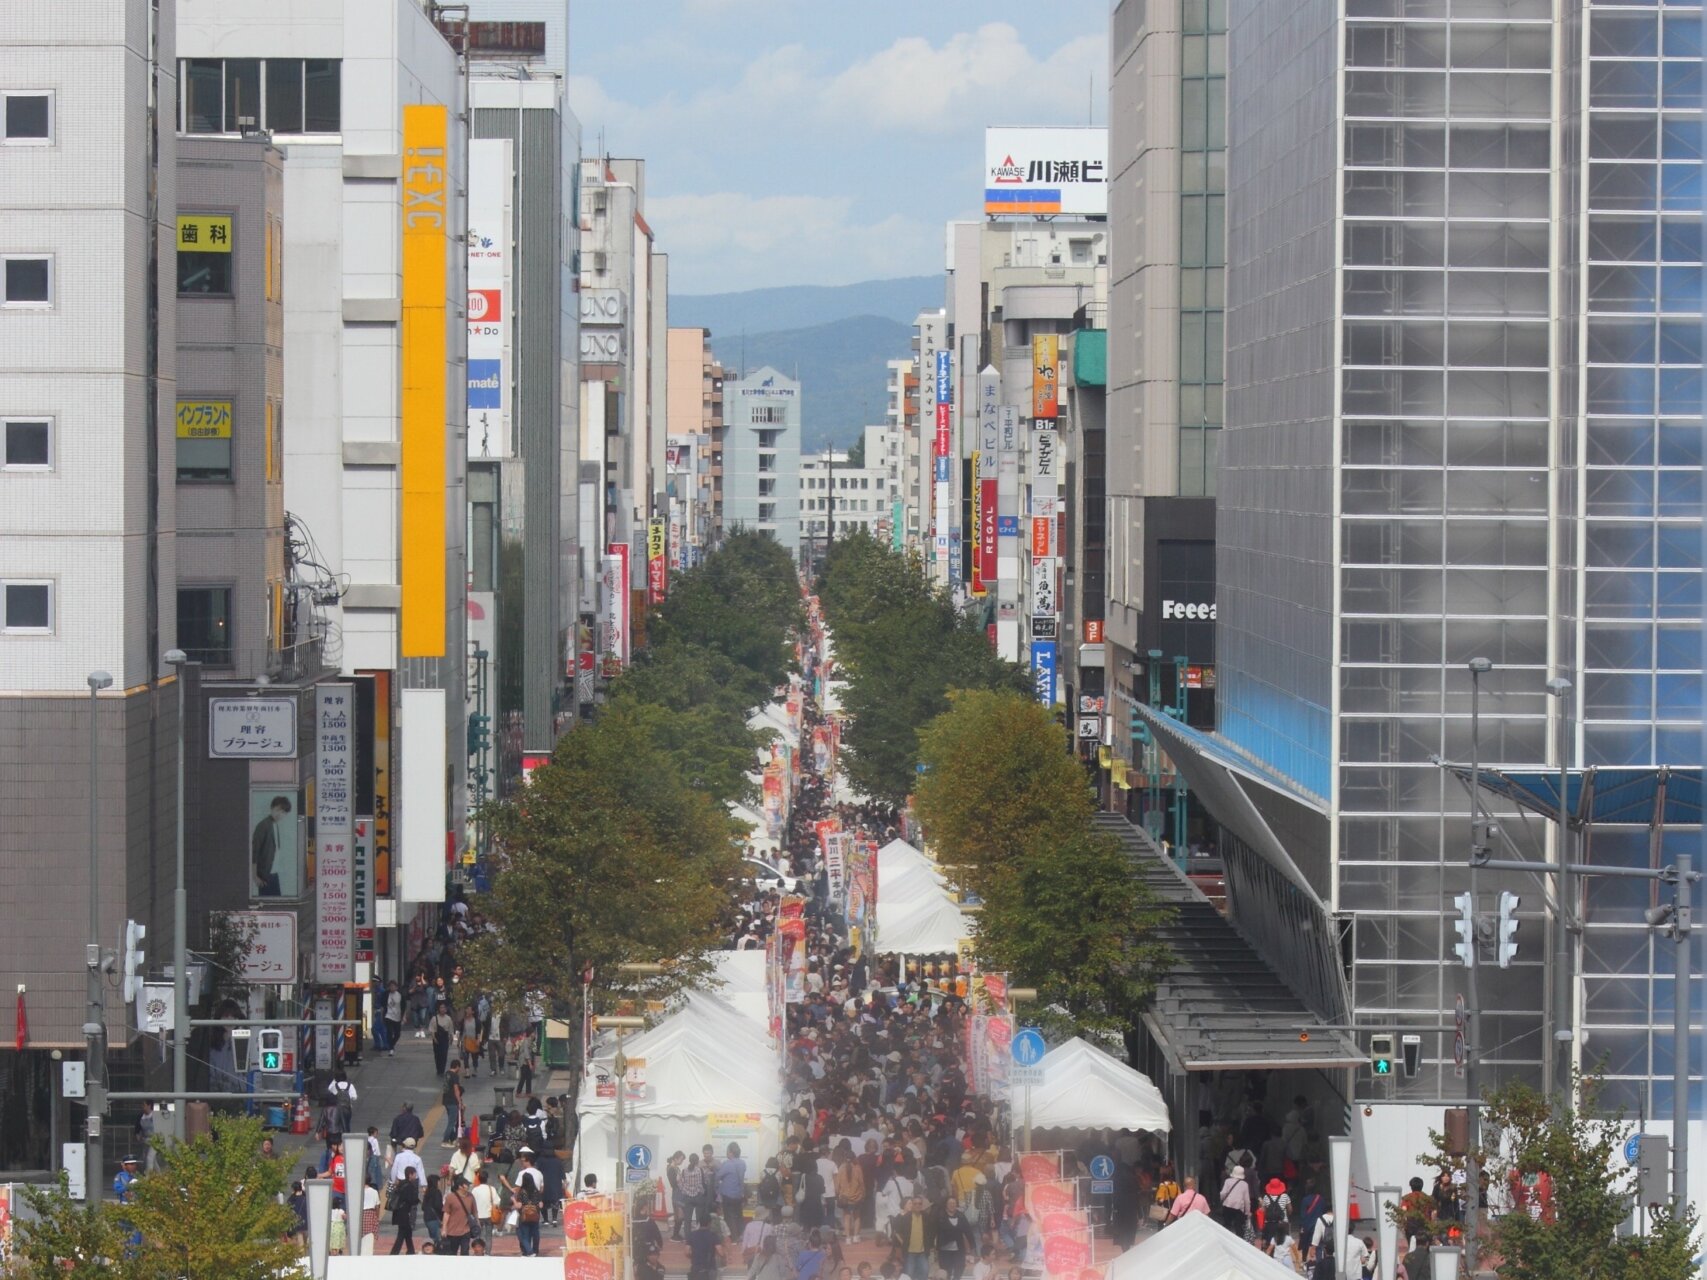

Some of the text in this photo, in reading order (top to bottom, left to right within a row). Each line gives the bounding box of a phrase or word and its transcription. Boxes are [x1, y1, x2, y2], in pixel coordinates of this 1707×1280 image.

[991, 167, 1025, 176] KAWASE
[1026, 160, 1107, 182] 川瀬ビ
[181, 223, 227, 244] 歯科
[178, 405, 230, 426] インプラント
[1035, 419, 1055, 430] B1F
[985, 506, 994, 554] REGAL
[324, 697, 344, 705] 理容
[322, 710, 346, 718] 大人
[322, 721, 347, 729] 1500
[240, 725, 267, 735] 理容
[324, 844, 345, 852] 美容
[322, 892, 347, 900] 1500
